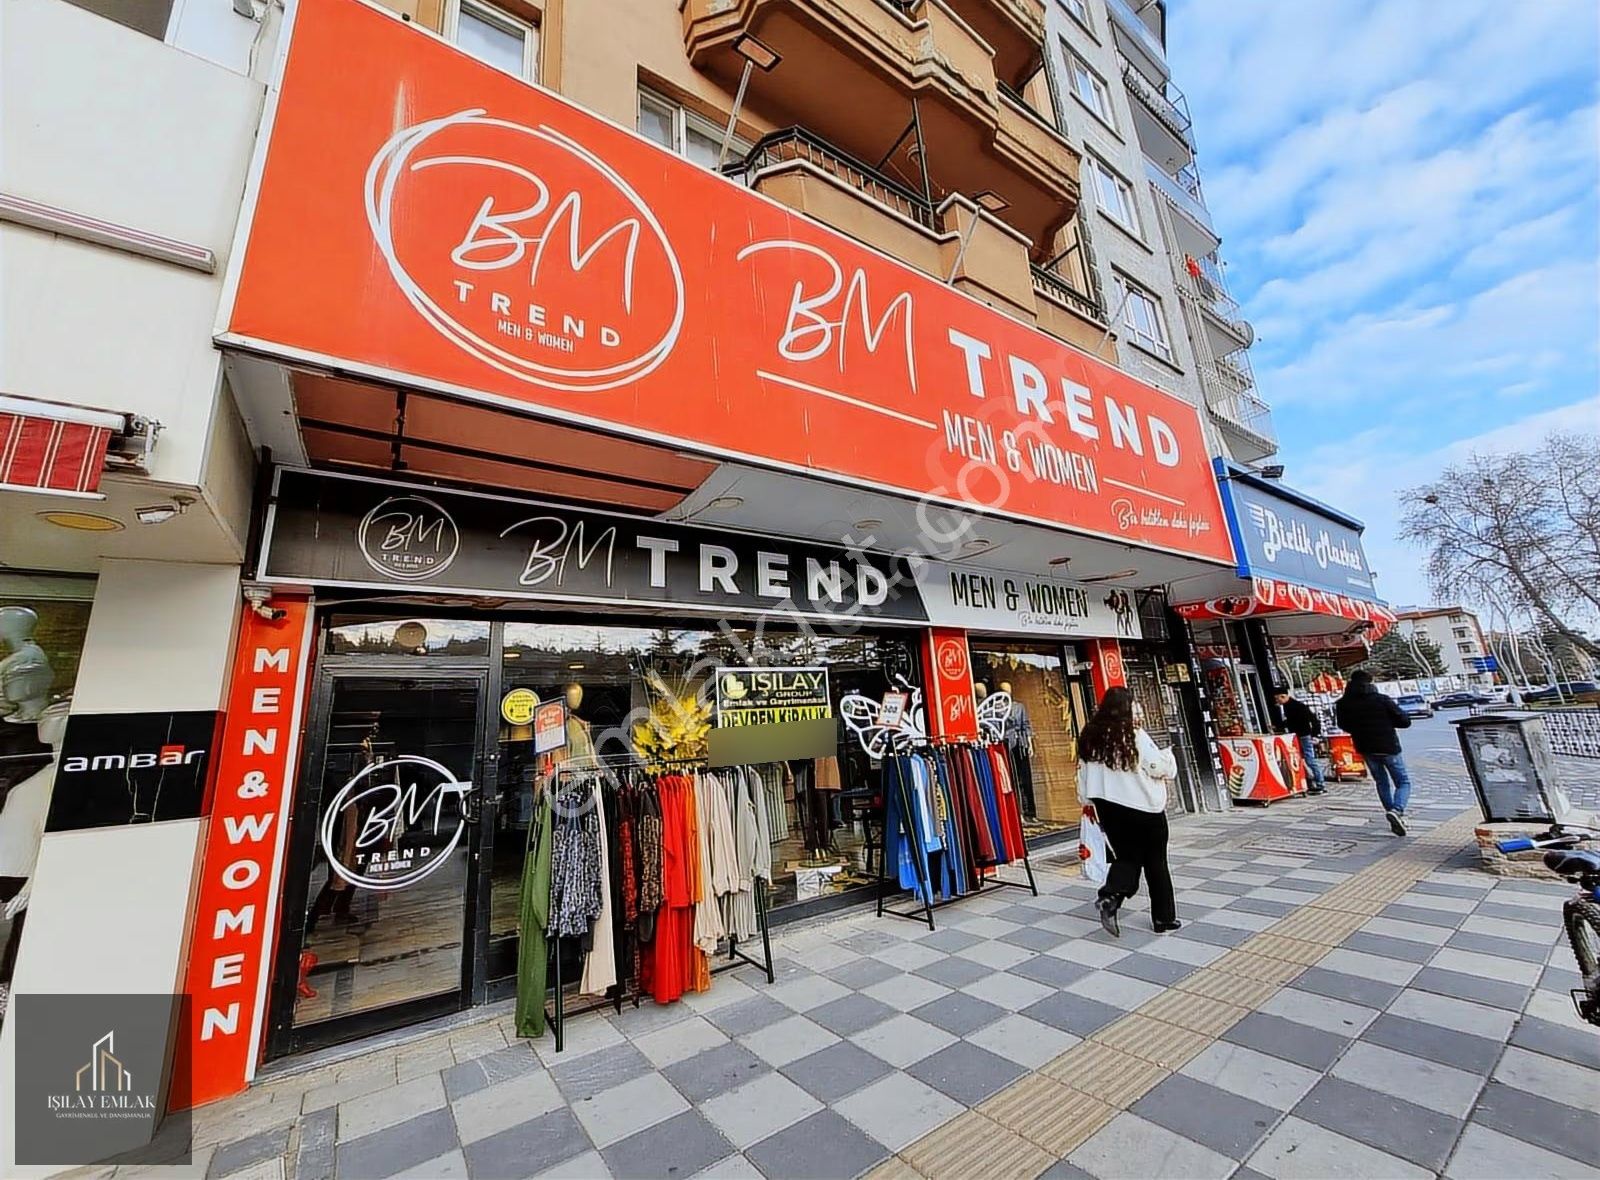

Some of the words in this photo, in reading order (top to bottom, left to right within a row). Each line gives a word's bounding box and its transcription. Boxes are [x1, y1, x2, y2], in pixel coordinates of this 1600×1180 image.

[411, 157, 640, 316] BM
[453, 279, 621, 348] TREND
[498, 319, 522, 339] MEN
[525, 323, 534, 342] &
[537, 331, 575, 354] WOMEN
[736, 240, 918, 395] BM
[948, 327, 1182, 468] TREND
[942, 408, 998, 466] MEN
[1003, 430, 1022, 474] &
[1027, 438, 1099, 495] WOMEN
[370, 512, 444, 553] BM
[381, 553, 435, 565] TREND
[500, 516, 617, 589] BM
[636, 535, 889, 607] TREND
[1263, 509, 1314, 563] Birlik
[1315, 530, 1363, 570] Market
[951, 571, 997, 610] MEN
[1003, 578, 1020, 612] &
[1026, 581, 1089, 618] WOMEN
[751, 672, 824, 697] IŞILAY
[340, 782, 444, 848] BM
[356, 847, 431, 865] TREND
